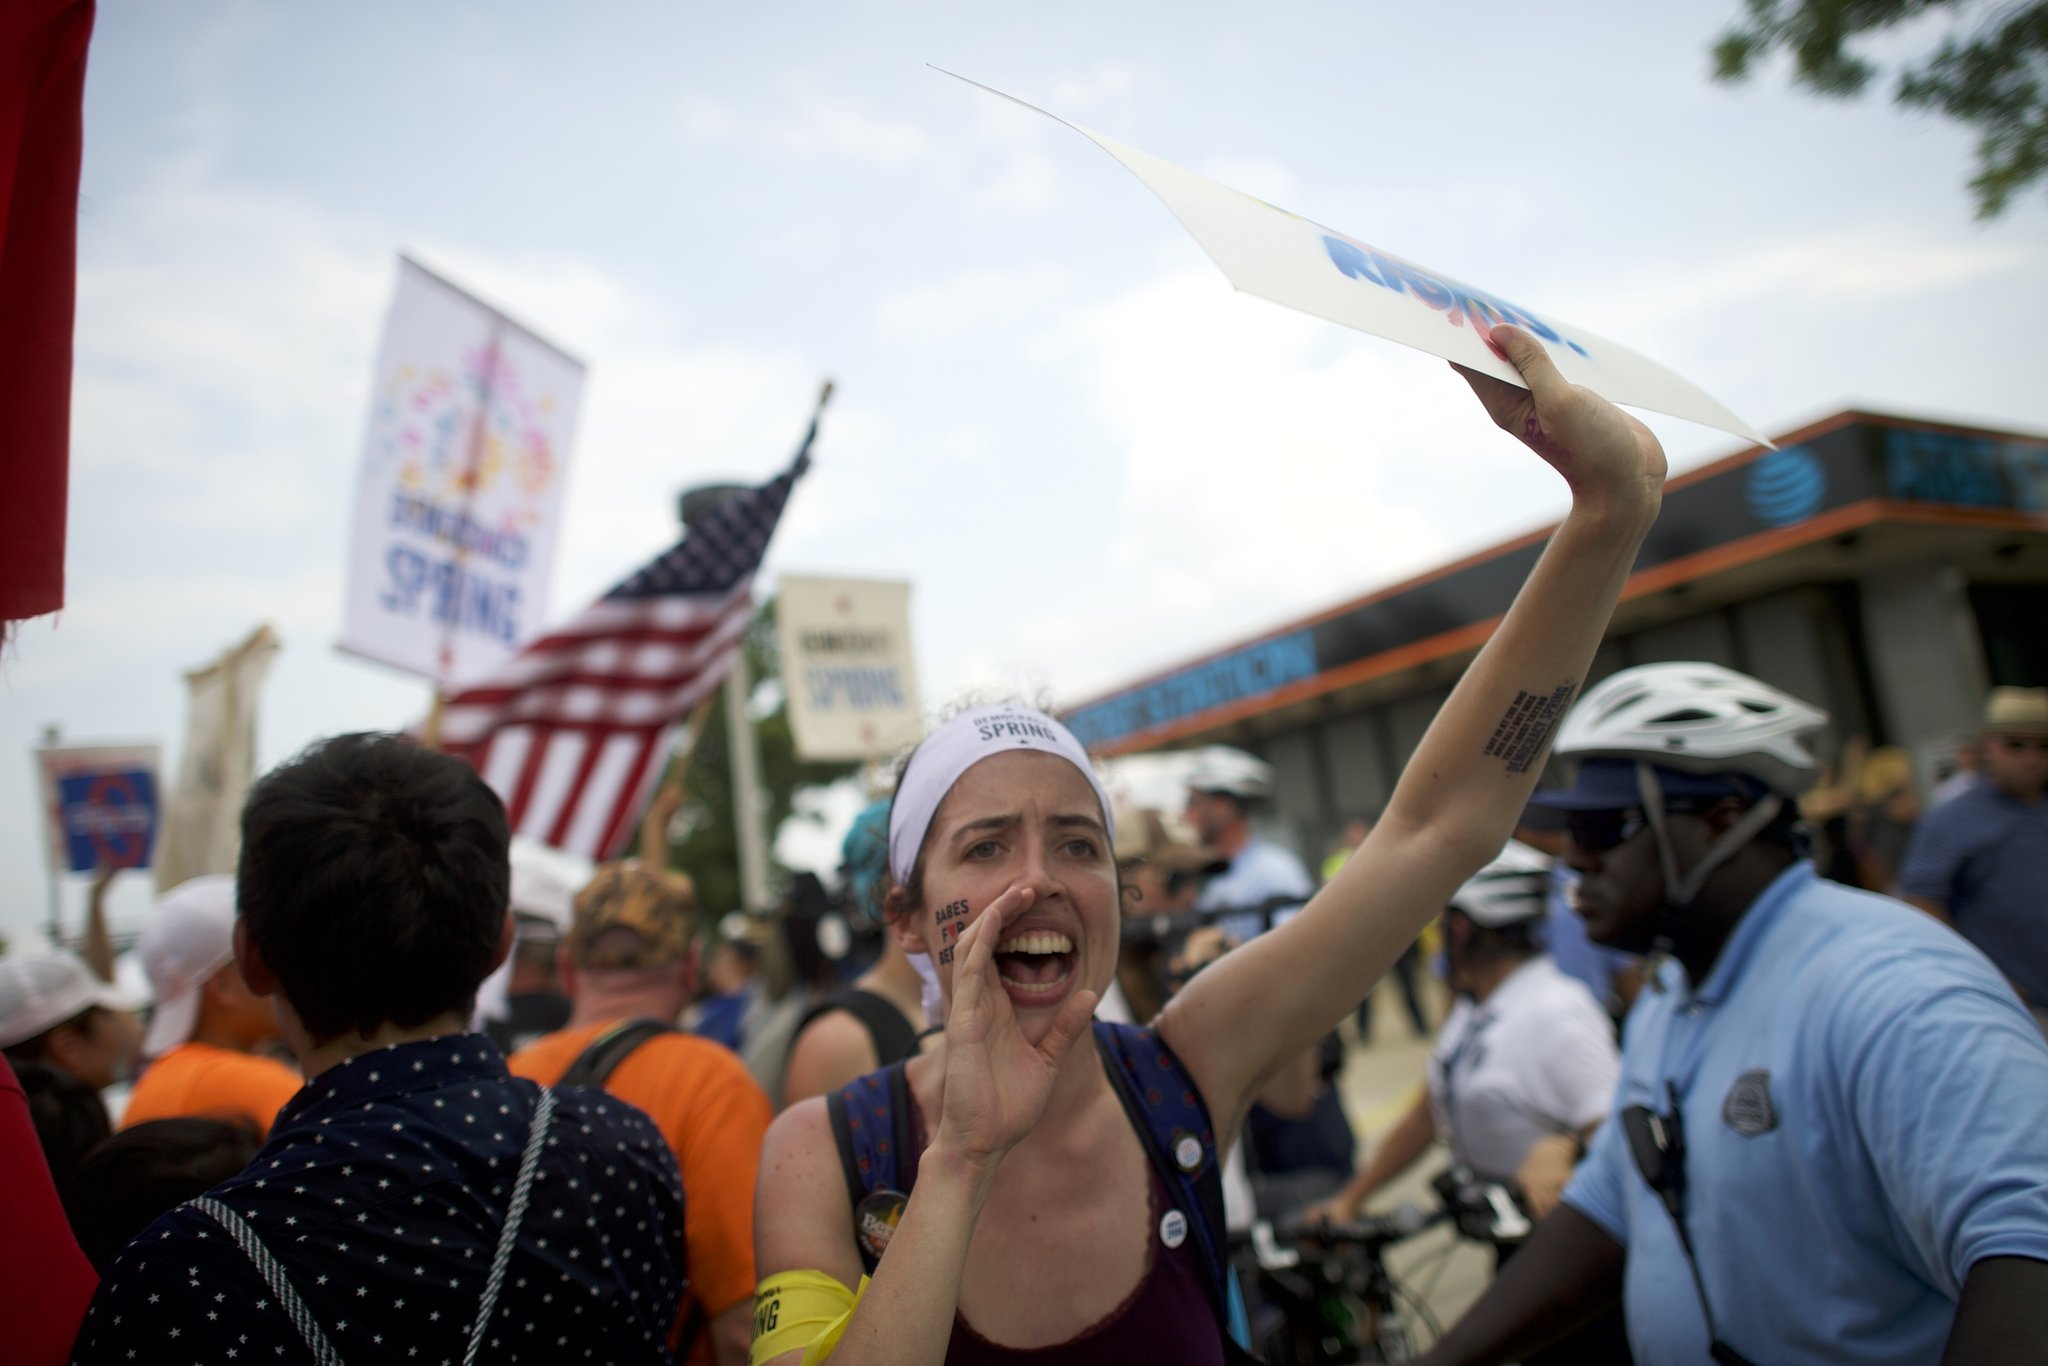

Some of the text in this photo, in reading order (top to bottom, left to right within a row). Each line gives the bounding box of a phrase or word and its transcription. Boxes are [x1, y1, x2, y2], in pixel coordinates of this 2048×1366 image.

[379, 543, 520, 645] SPRING
[979, 721, 1057, 743] SPRING
[1506, 720, 1548, 773] DEMOCRACY
[1539, 686, 1569, 720] SPRING
[935, 899, 969, 926] BABES
